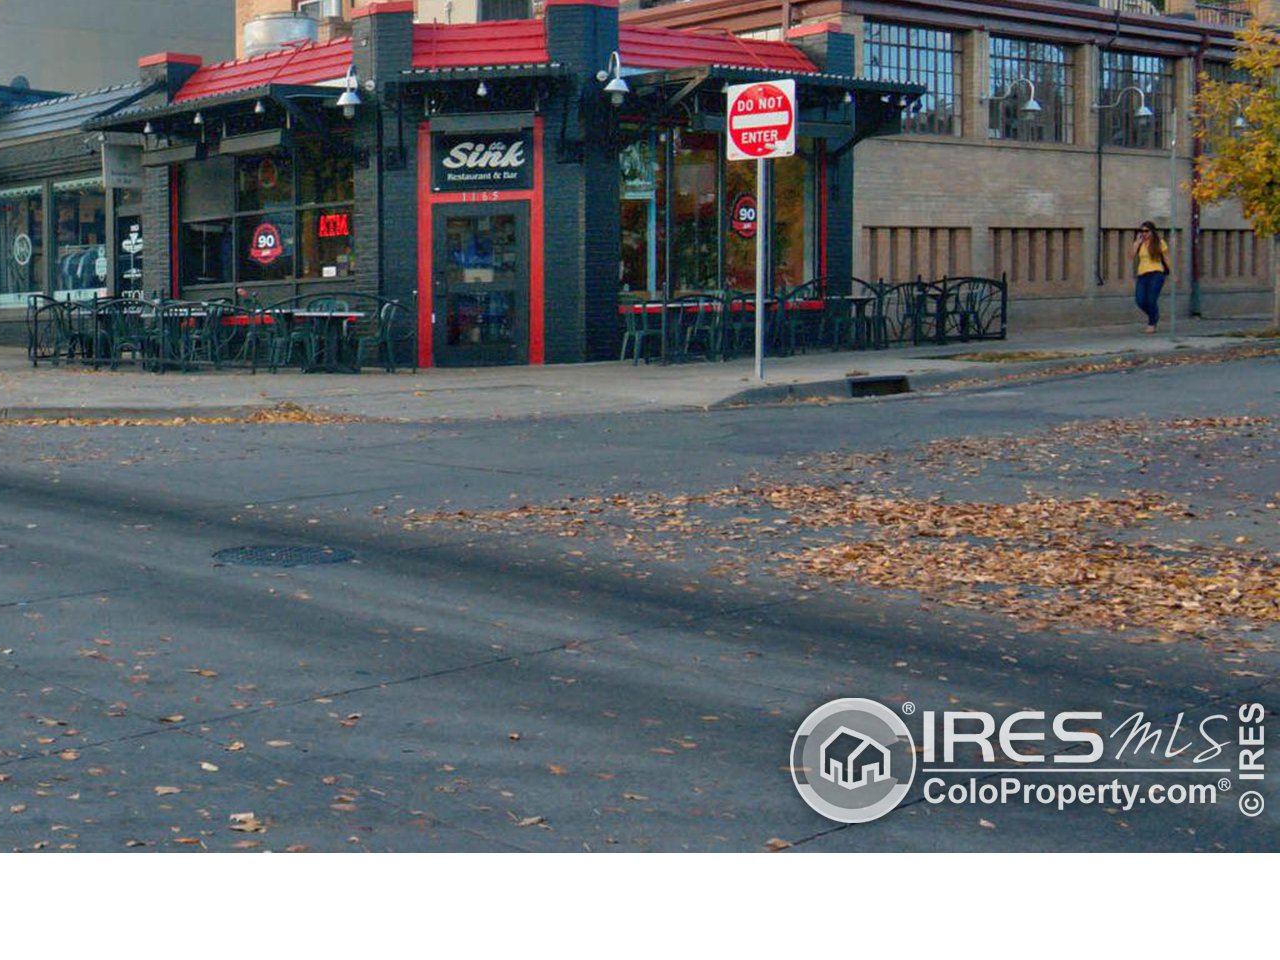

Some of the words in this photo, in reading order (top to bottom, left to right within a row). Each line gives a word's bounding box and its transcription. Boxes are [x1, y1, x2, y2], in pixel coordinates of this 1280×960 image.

[737, 99, 754, 112] DO
[758, 96, 783, 110] NOT
[741, 129, 778, 144] ENTER
[442, 141, 525, 168] Sink
[447, 173, 492, 181] Restaurant
[503, 171, 518, 179] Bar
[463, 191, 499, 201] 1165
[739, 208, 755, 220] 90
[320, 214, 349, 237] ATM
[258, 235, 275, 248] 90
